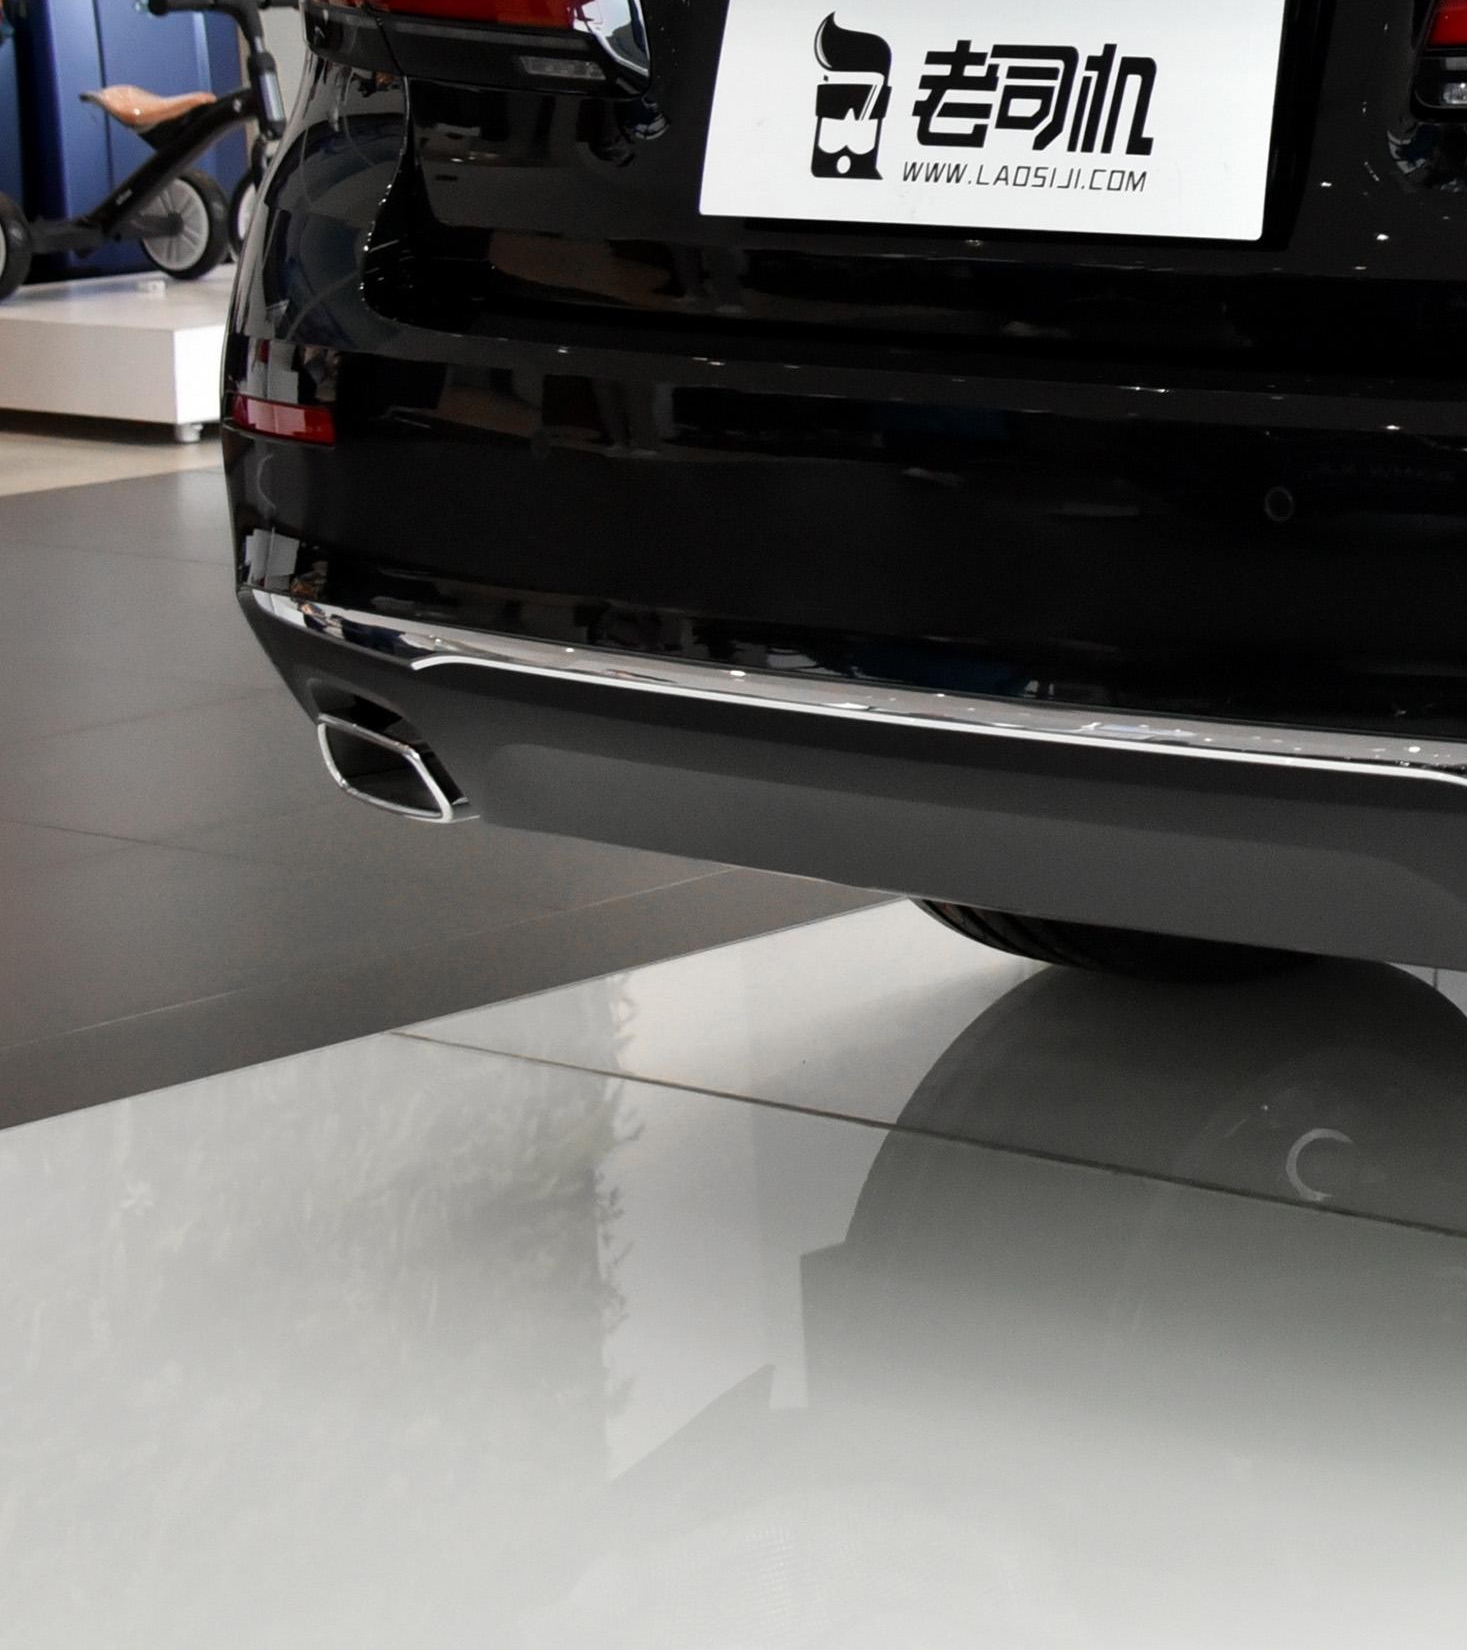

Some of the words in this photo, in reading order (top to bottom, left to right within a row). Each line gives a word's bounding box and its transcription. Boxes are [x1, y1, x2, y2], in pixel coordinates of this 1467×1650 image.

[911, 39, 1158, 156] 老司机
[902, 160, 1147, 193] WWW.LAOSIJI.COM
